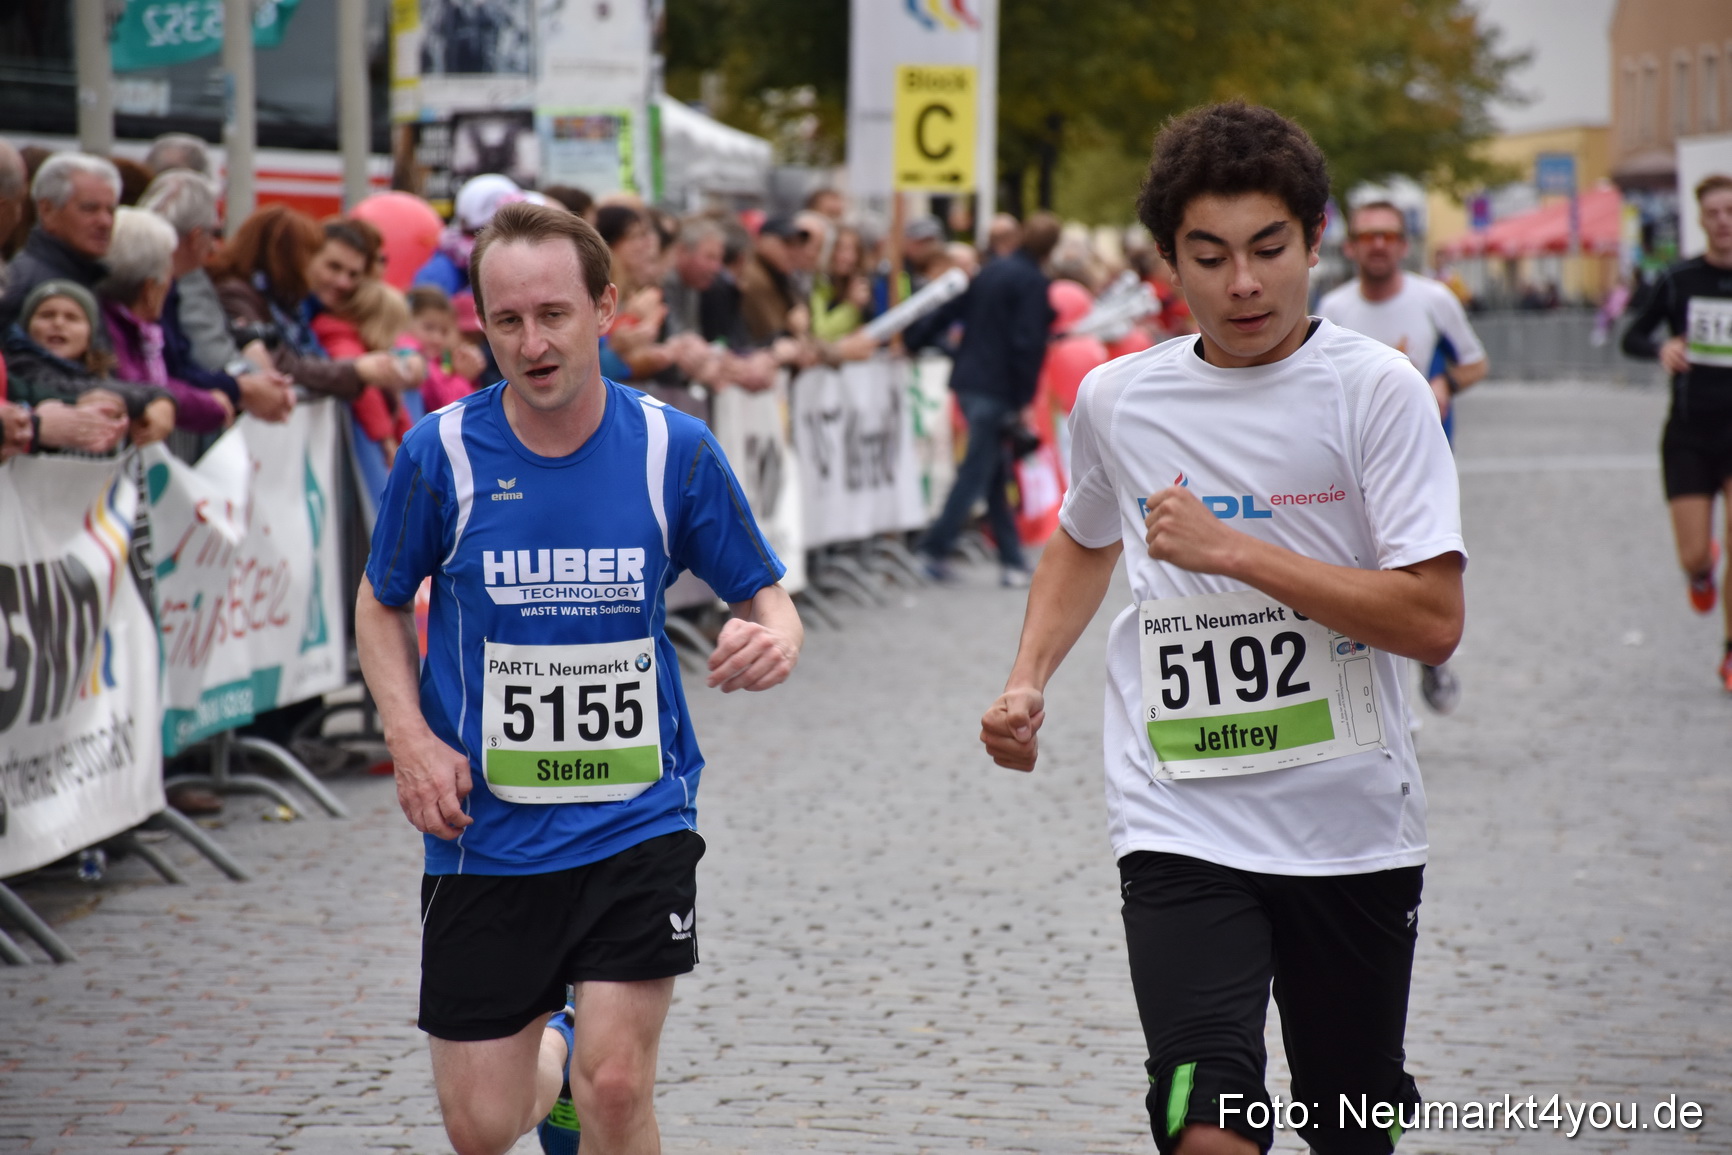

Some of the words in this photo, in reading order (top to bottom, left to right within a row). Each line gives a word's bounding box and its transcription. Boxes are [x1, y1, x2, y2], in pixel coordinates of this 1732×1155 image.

[914, 103, 955, 162] C
[491, 491, 523, 501] erima
[1270, 484, 1346, 506] energie
[483, 547, 645, 585] HUBER
[519, 587, 641, 600] TECHNOLOGY
[520, 607, 558, 617] WASTE
[560, 606, 598, 616] WATER
[599, 604, 641, 615] Solutions
[1144, 616, 1193, 635] PARTL
[1196, 606, 1286, 630] Neumarkt
[489, 660, 545, 676] PARTL
[549, 660, 629, 676] Neumarkt
[1158, 631, 1311, 710] 5192
[503, 681, 644, 742] 5155
[491, 736, 498, 747] S
[1194, 724, 1279, 752] Jeffrey
[537, 759, 610, 781] Stefan
